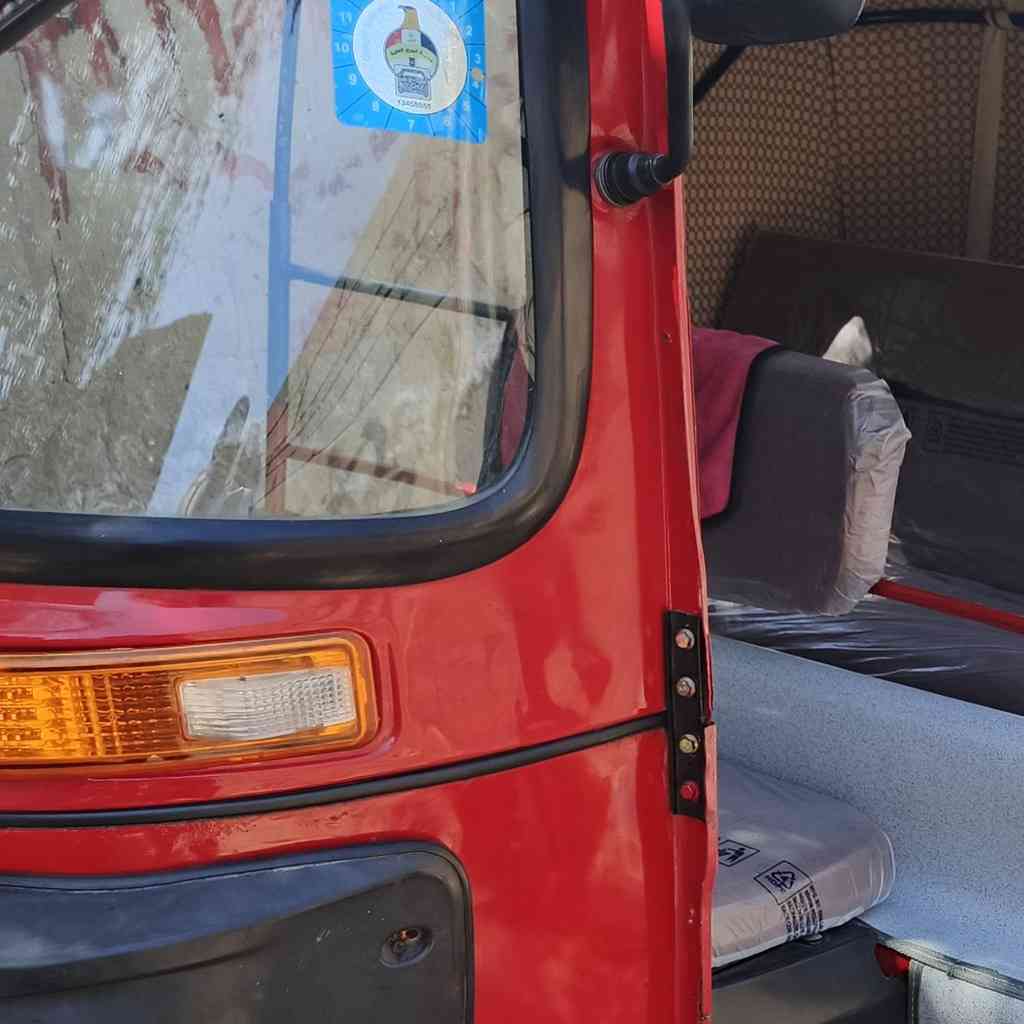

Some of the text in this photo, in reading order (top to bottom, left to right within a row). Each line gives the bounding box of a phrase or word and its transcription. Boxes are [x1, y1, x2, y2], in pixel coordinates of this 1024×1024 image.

[465, 25, 473, 37] 2
[335, 43, 350, 54] 10
[474, 54, 481, 64] 3
[349, 73, 358, 86] 9
[408, 119, 416, 132] 7
